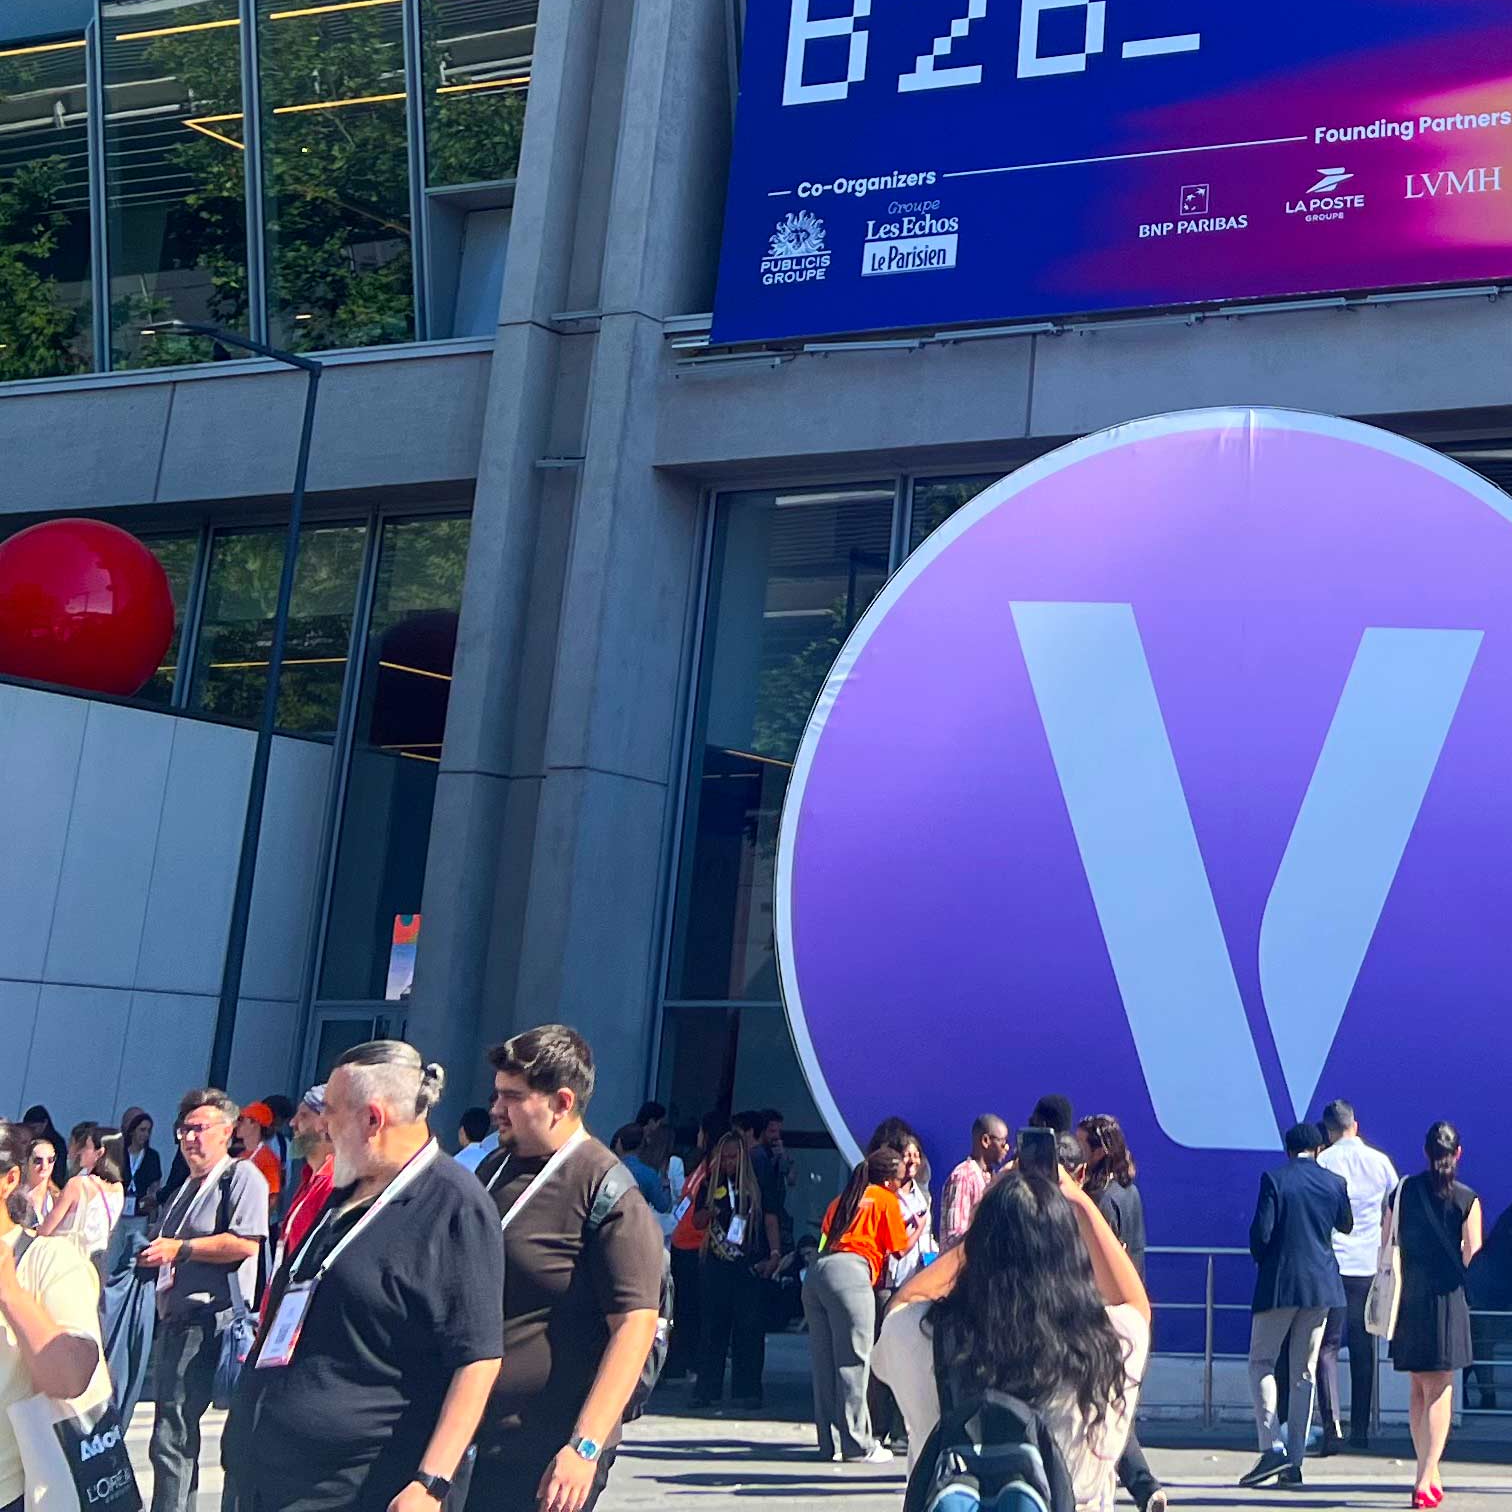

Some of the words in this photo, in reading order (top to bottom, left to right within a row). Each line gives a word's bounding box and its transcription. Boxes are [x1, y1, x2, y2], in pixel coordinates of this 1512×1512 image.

[1314, 119, 1414, 144] Founding
[1418, 109, 1512, 133] Partners
[797, 171, 937, 198] Co-Organizers
[1404, 166, 1503, 199] LVMH
[887, 199, 941, 215] Groupe
[1285, 199, 1307, 214] LA
[1309, 194, 1365, 211] POSTE
[1138, 222, 1174, 238] BNP
[1177, 215, 1249, 234] PARIBAS
[1305, 211, 1344, 222] GROUPE
[760, 254, 831, 273] PUBLICIS
[887, 244, 947, 270] Parisien
[762, 268, 827, 286] GROUPE
[1008, 600, 1486, 1152] V
